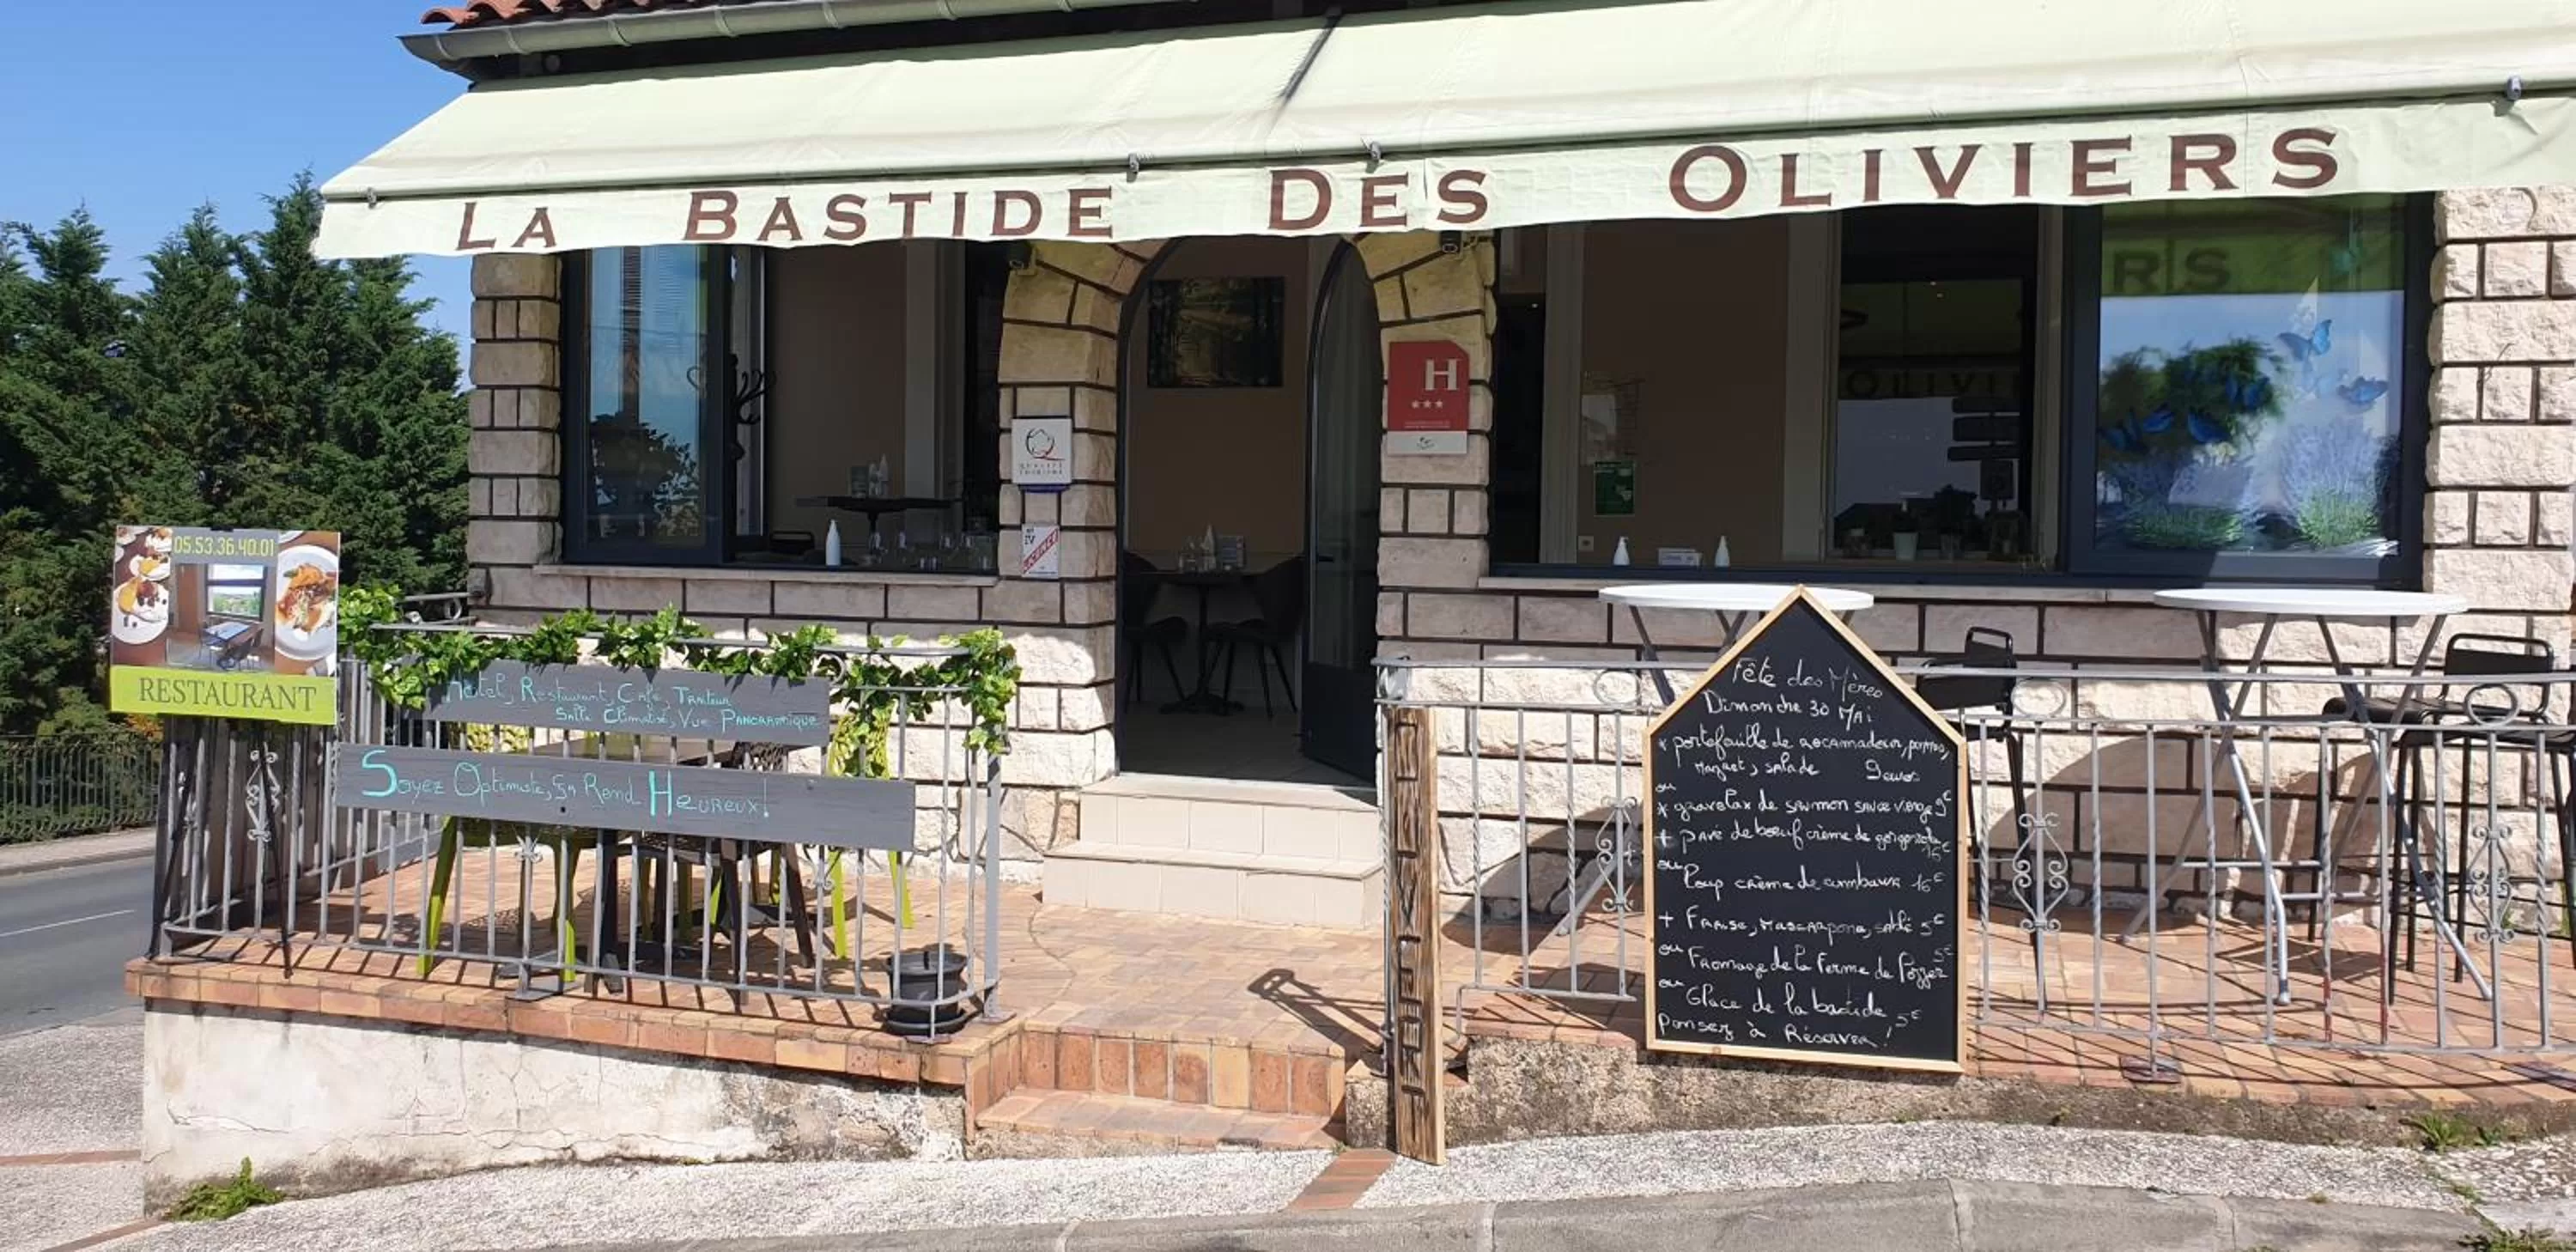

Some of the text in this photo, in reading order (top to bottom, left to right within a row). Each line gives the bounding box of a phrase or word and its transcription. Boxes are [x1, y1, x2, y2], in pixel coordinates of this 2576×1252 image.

[456, 127, 2339, 251] LA BASTIDE DES OLIVIERS
[1425, 359, 1458, 391] H
[1787, 658, 1824, 688] des
[138, 677, 317, 712] RESTAURANT
[1808, 699, 1831, 718] 30
[1771, 727, 1795, 750] de
[361, 748, 446, 805] Soyez
[1758, 787, 1779, 811] de
[1730, 818, 1754, 842] de
[1854, 824, 1871, 842] de
[1797, 864, 1821, 891] de
[1770, 945, 1795, 971] de
[1794, 944, 1813, 971] la
[1874, 955, 1894, 981] de
[1752, 987, 1776, 1014] de
[1783, 982, 1809, 1016] la
[1746, 1018, 1767, 1038] à
